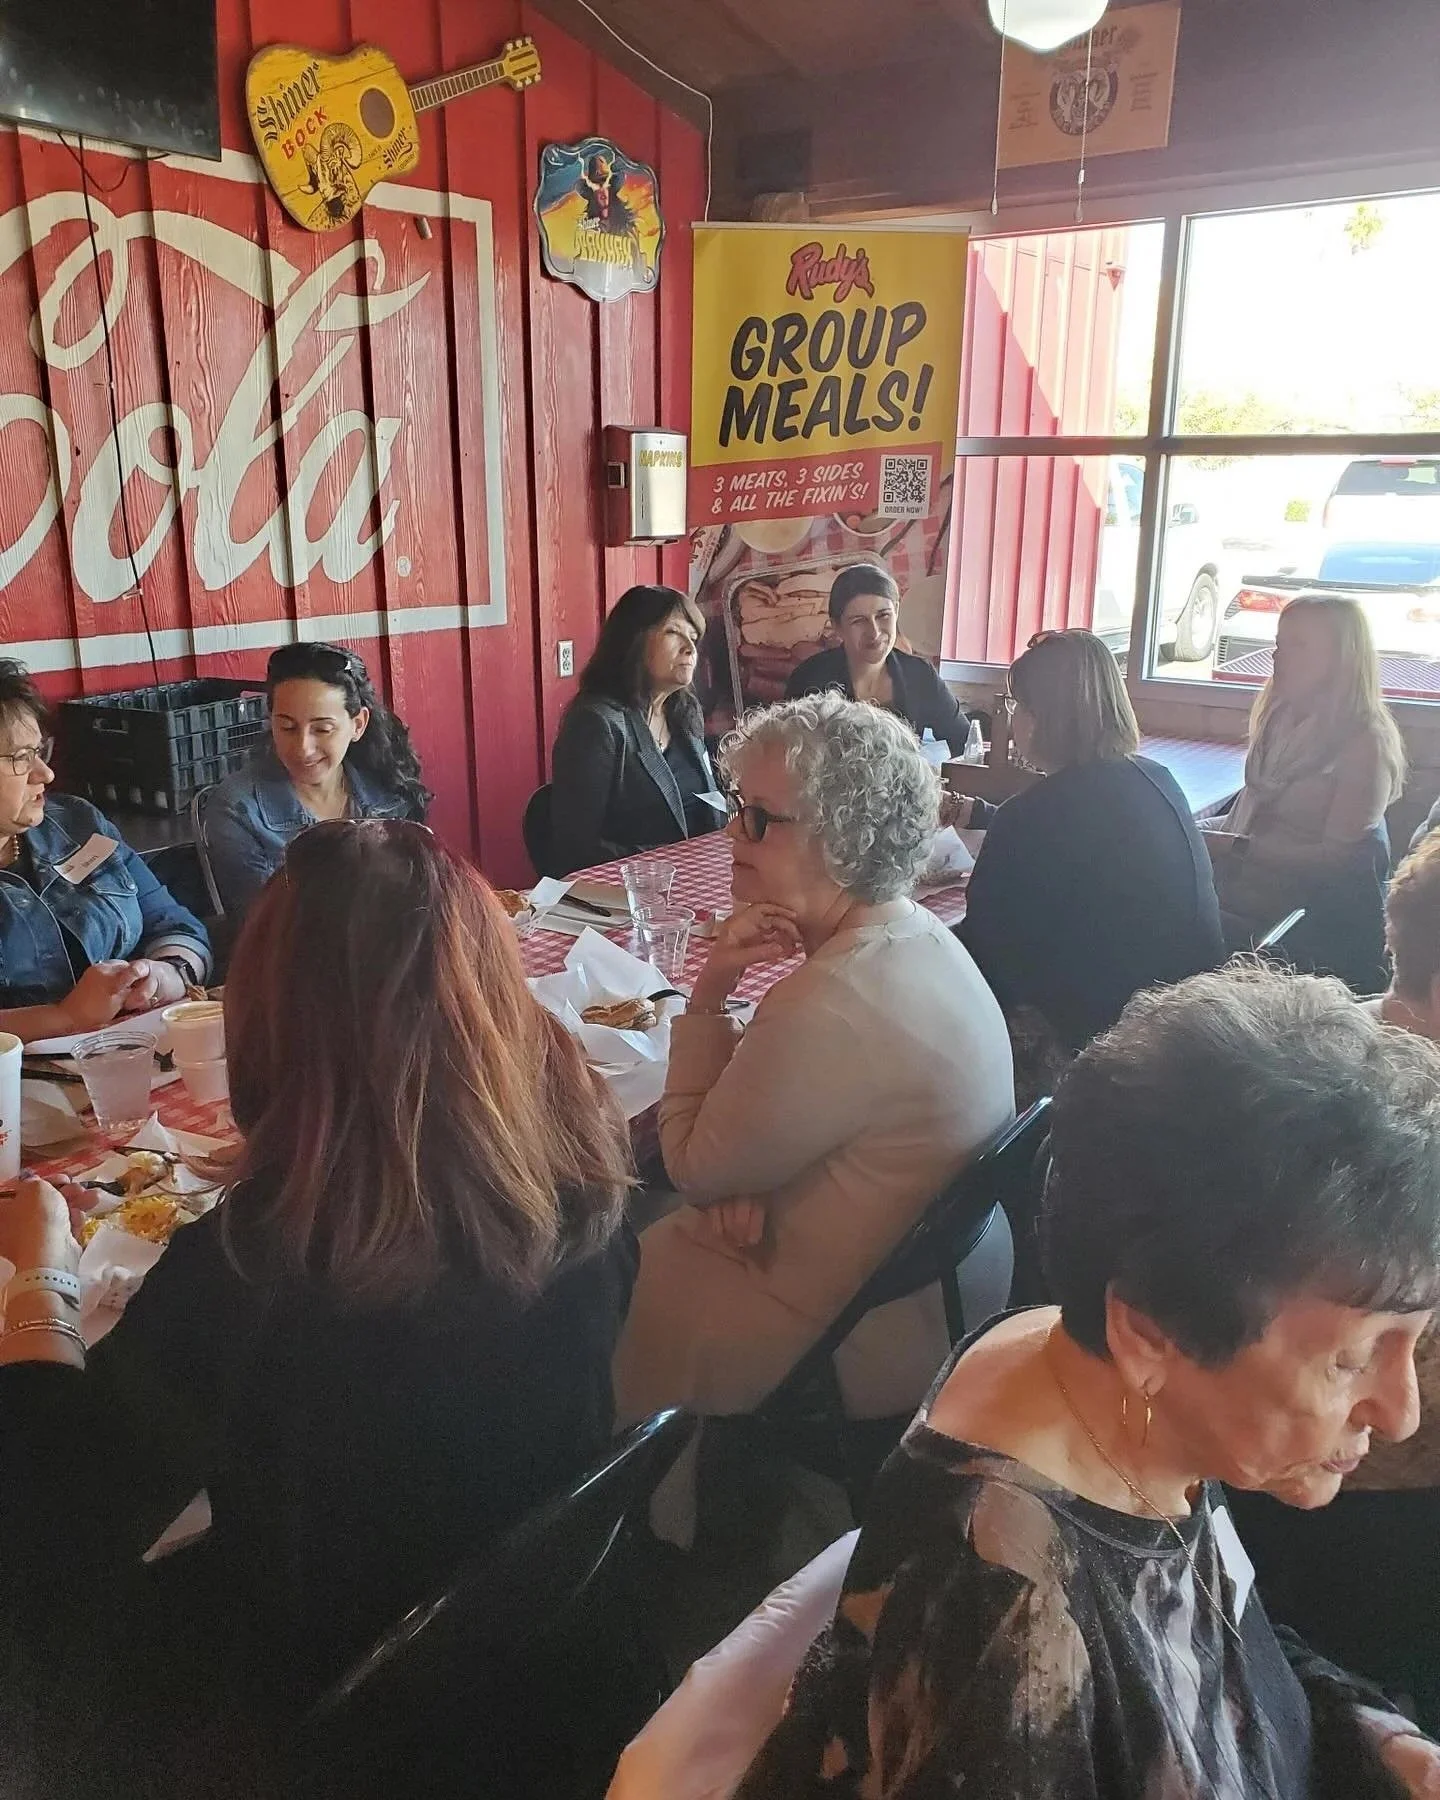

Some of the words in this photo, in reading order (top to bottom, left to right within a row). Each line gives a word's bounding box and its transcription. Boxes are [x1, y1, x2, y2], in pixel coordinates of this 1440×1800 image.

[256, 60, 322, 147] Shiner
[281, 106, 328, 160] BOCK
[786, 242, 875, 303] Rudy's
[731, 301, 928, 381] GROUP
[719, 363, 935, 448] MEALS!
[639, 449, 683, 468] NAPKINS
[712, 476, 725, 493] 3
[729, 470, 789, 492] MEATS,
[795, 467, 807, 485] 3
[812, 462, 865, 484] SIDES
[711, 497, 723, 514] &
[730, 493, 757, 513] ALL
[765, 489, 797, 509] THE
[802, 481, 869, 506] FIXIN'S!
[884, 505, 905, 514] ORDER
